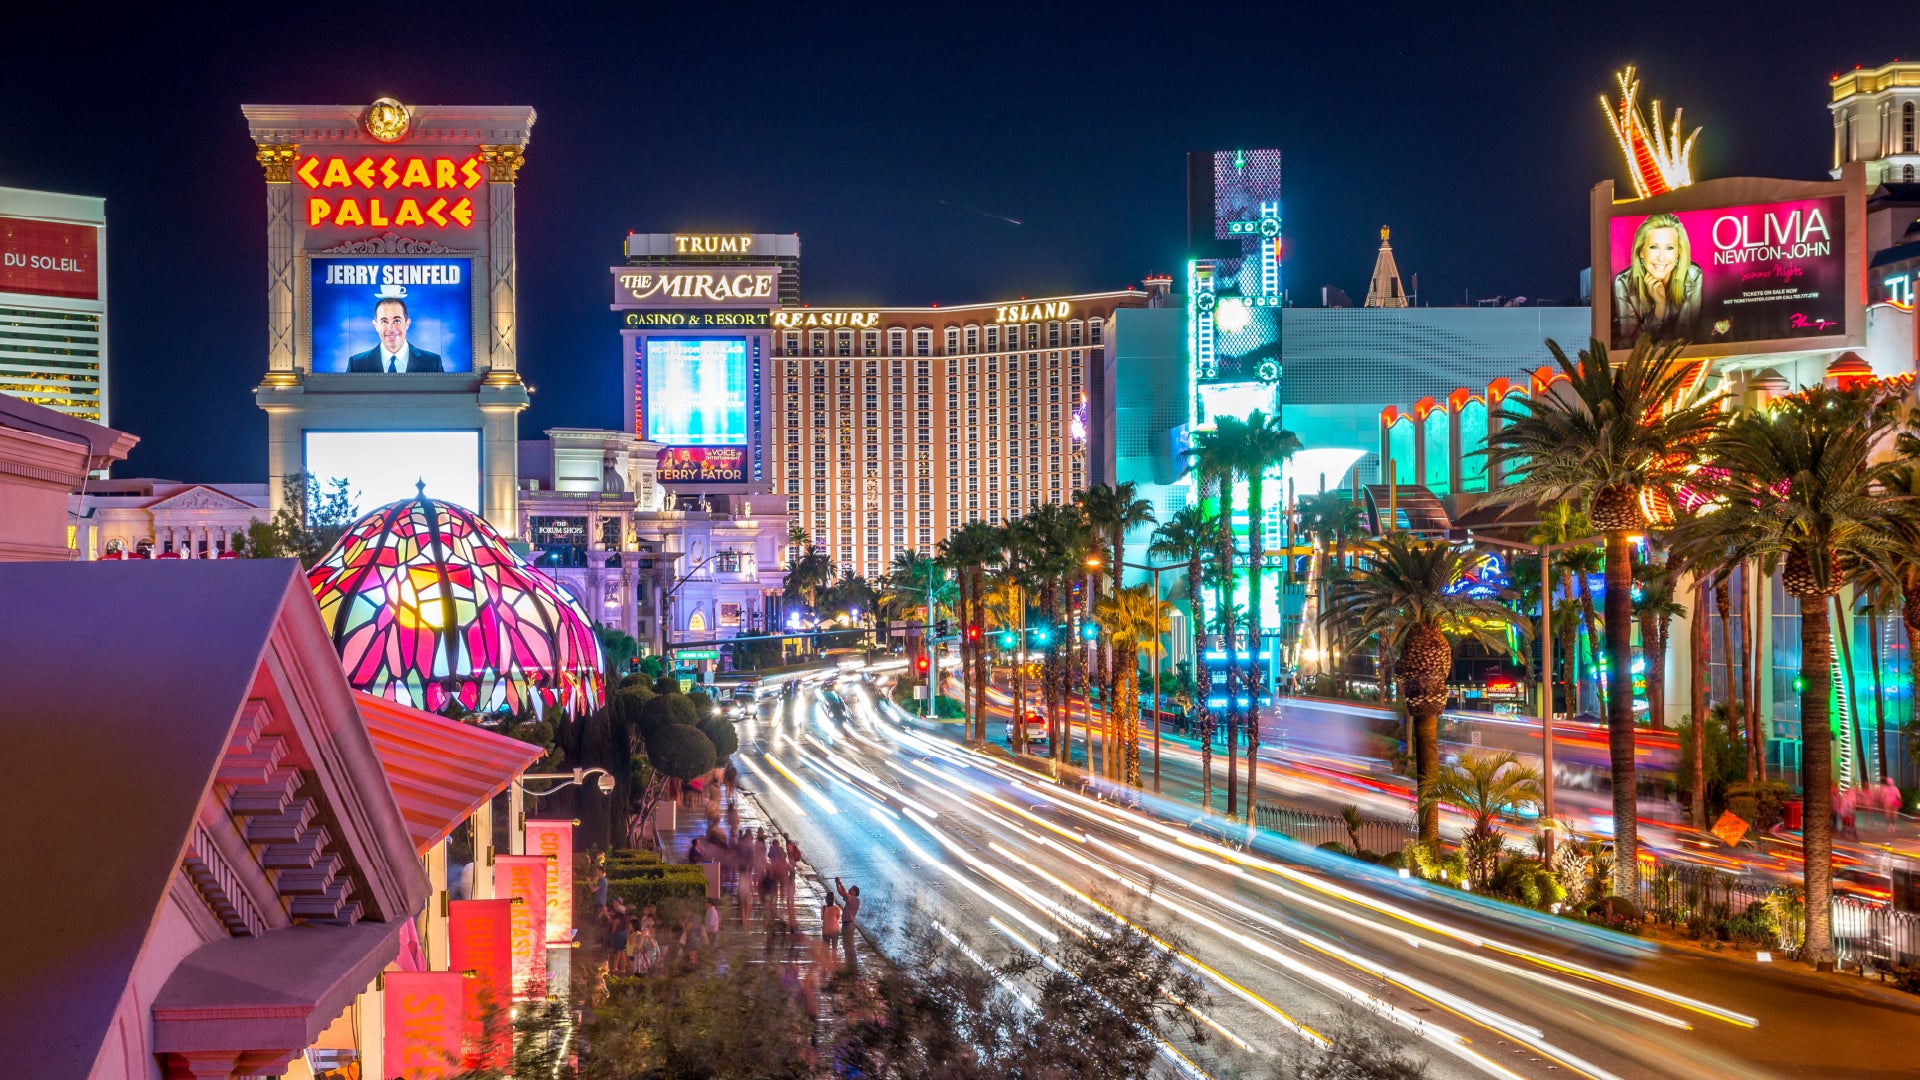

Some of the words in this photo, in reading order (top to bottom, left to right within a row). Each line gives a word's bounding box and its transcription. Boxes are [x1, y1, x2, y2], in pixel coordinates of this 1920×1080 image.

[298, 157, 482, 189] CAESARS
[310, 197, 472, 227] PALACE
[1712, 208, 1831, 250] OLIVIA
[676, 237, 751, 252] TRUMP
[1714, 241, 1830, 265] NEWTON-JOHN
[4, 252, 26, 267] DU
[31, 255, 82, 272] SOLEIL
[1773, 262, 1804, 283] Nights
[326, 264, 380, 284] JERRY
[382, 264, 461, 284] SEINFELD
[620, 274, 652, 289] THE
[632, 274, 773, 300] MIRAGE
[626, 313, 685, 325] CASINO
[690, 314, 700, 325] &
[705, 313, 768, 325] RESORT
[769, 311, 880, 327] REASURE
[996, 301, 1070, 323] ISLAND
[656, 469, 698, 480] TERRY
[701, 469, 742, 480] FATOR
